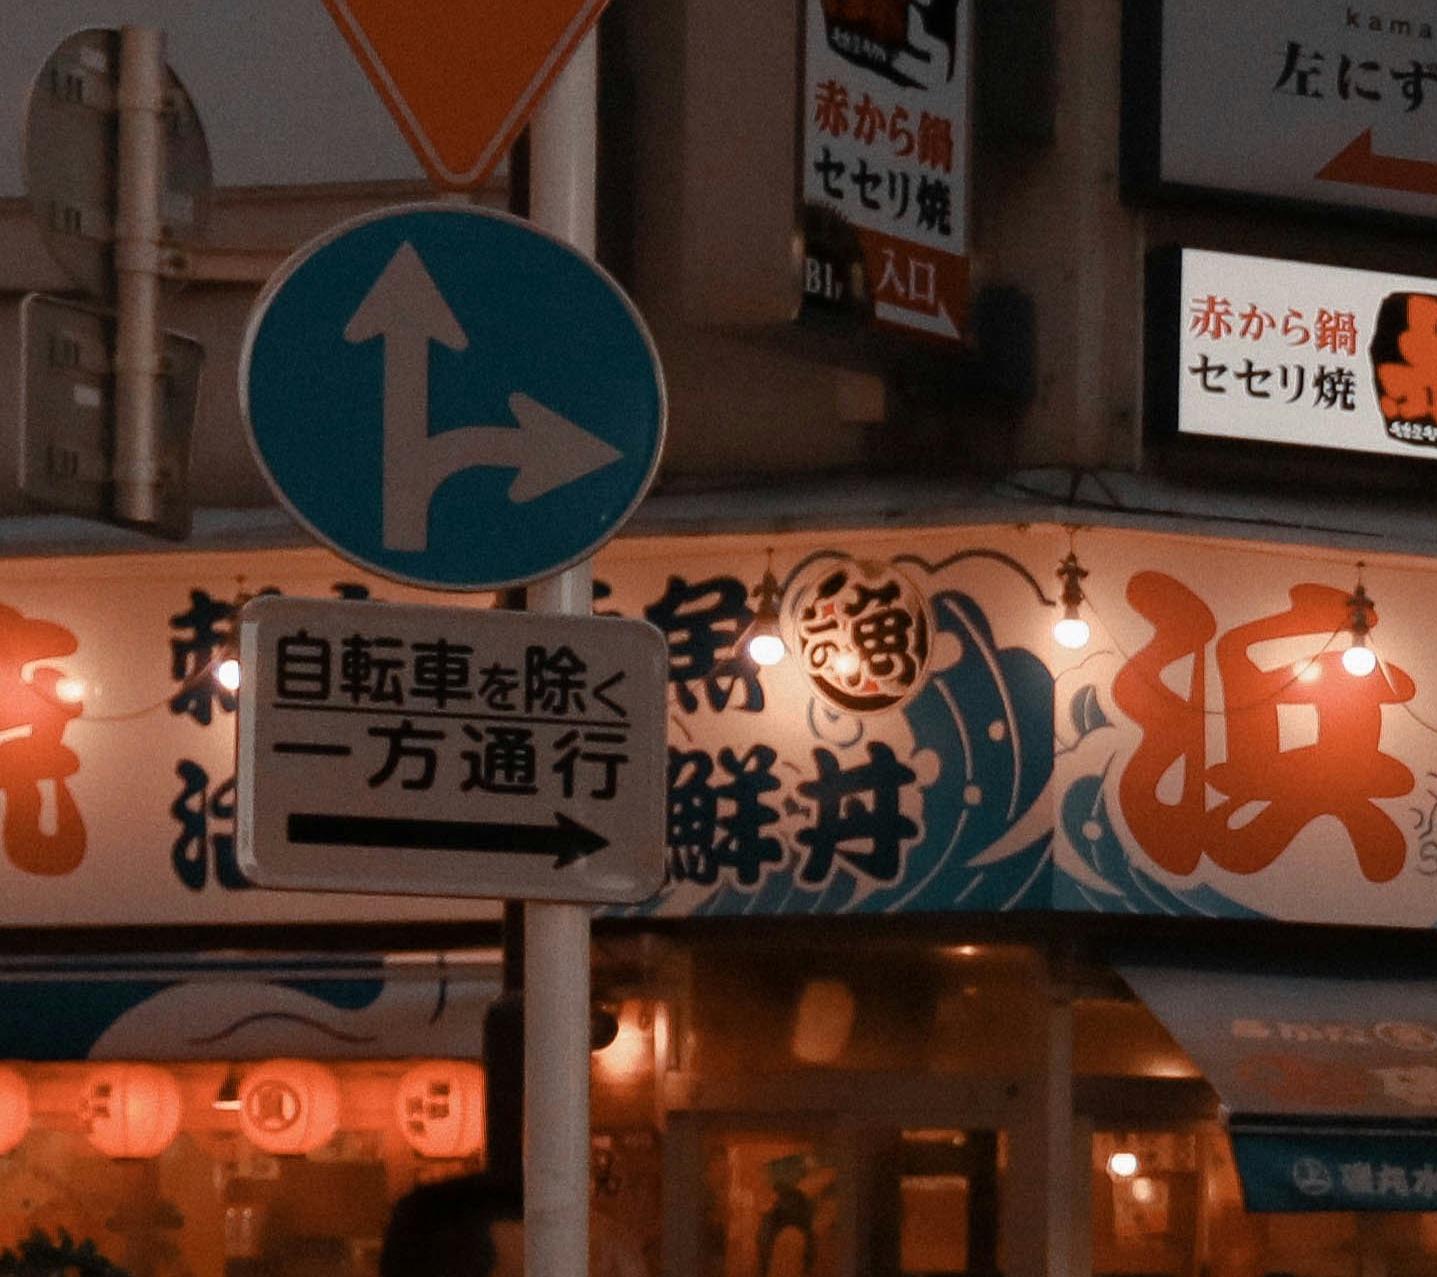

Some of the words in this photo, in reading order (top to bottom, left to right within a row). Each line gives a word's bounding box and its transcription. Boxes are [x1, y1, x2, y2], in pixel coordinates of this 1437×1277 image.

[814, 80, 954, 174] 赤から鍋
[814, 146, 952, 237] セセリ焼
[804, 257, 844, 301] B1F
[876, 249, 936, 306] 入口
[1190, 294, 1358, 357] 赤から鍋
[1188, 354, 1357, 412] セセリ焼
[275, 630, 628, 718] 自転車を除く
[272, 722, 630, 801] 一方通行
